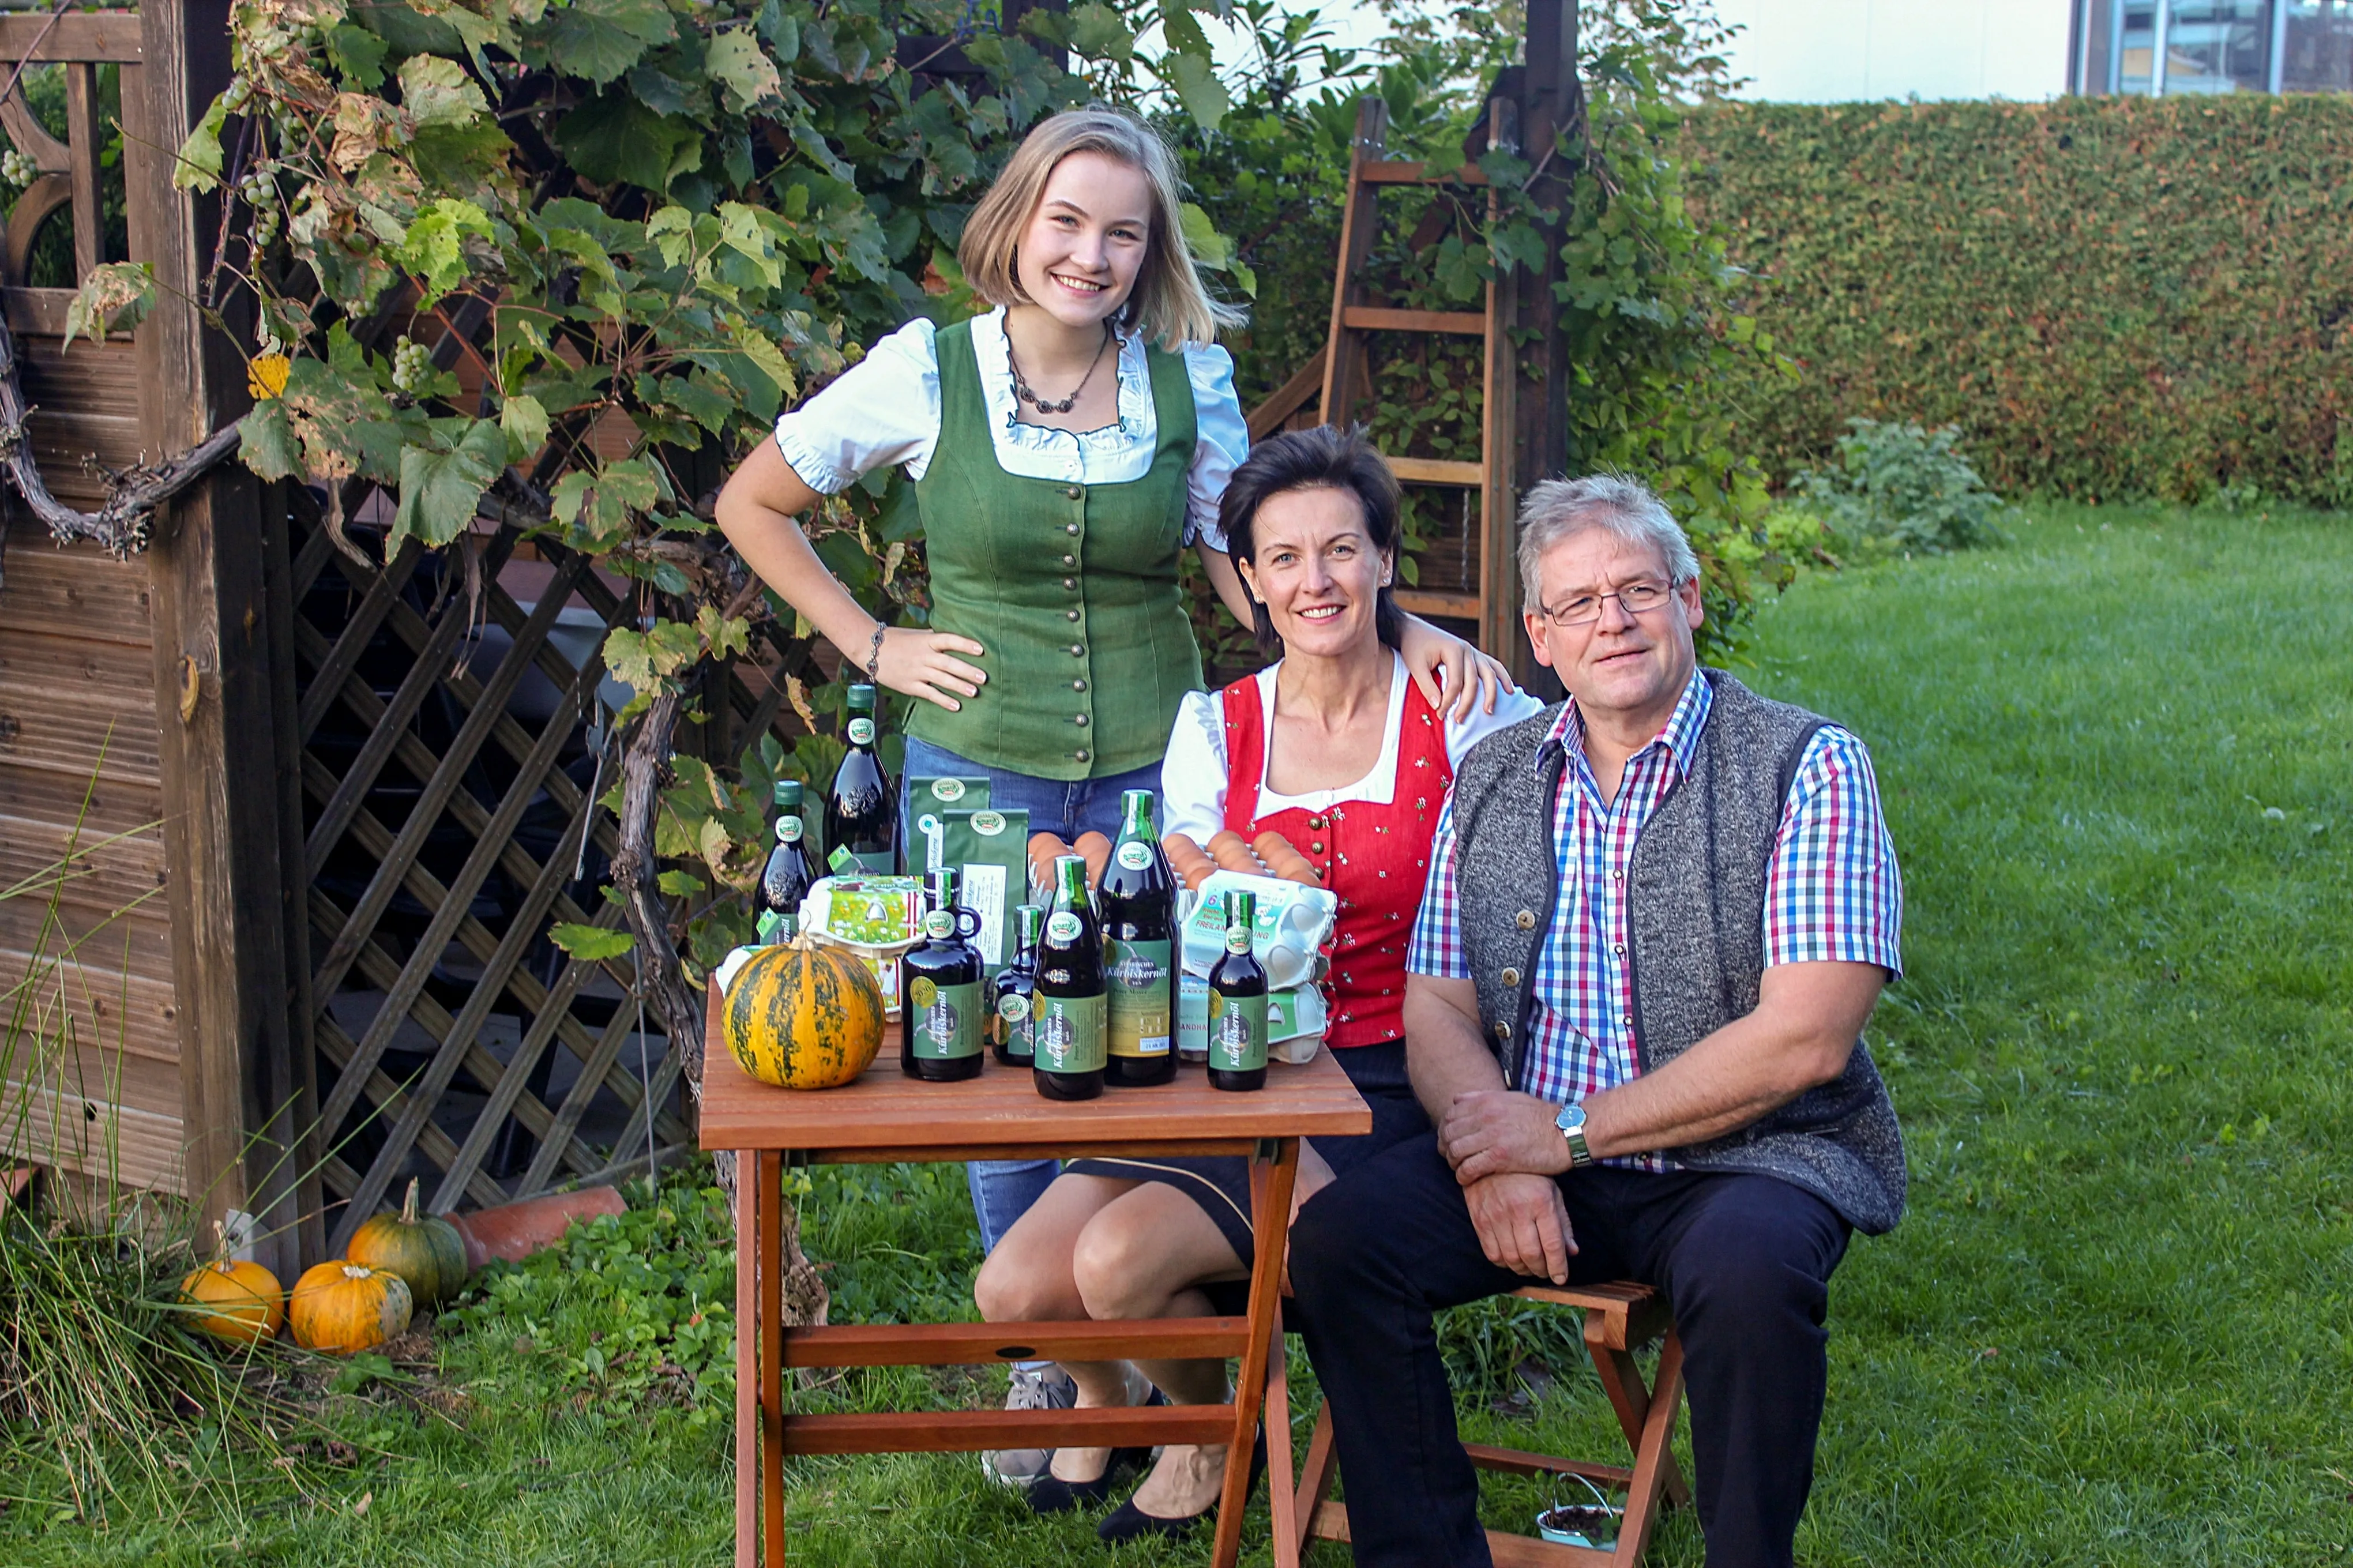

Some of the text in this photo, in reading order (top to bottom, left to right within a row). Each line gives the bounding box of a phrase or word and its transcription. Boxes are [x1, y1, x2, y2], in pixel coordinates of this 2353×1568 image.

[1208, 894, 1217, 905] 6
[1107, 967, 1167, 979] Kürbiskernöl
[937, 990, 948, 1055] Kürbiskernöl
[1053, 1002, 1063, 1069] Kürbiskernöl
[1230, 1002, 1240, 1067] Kürbiskernöl
